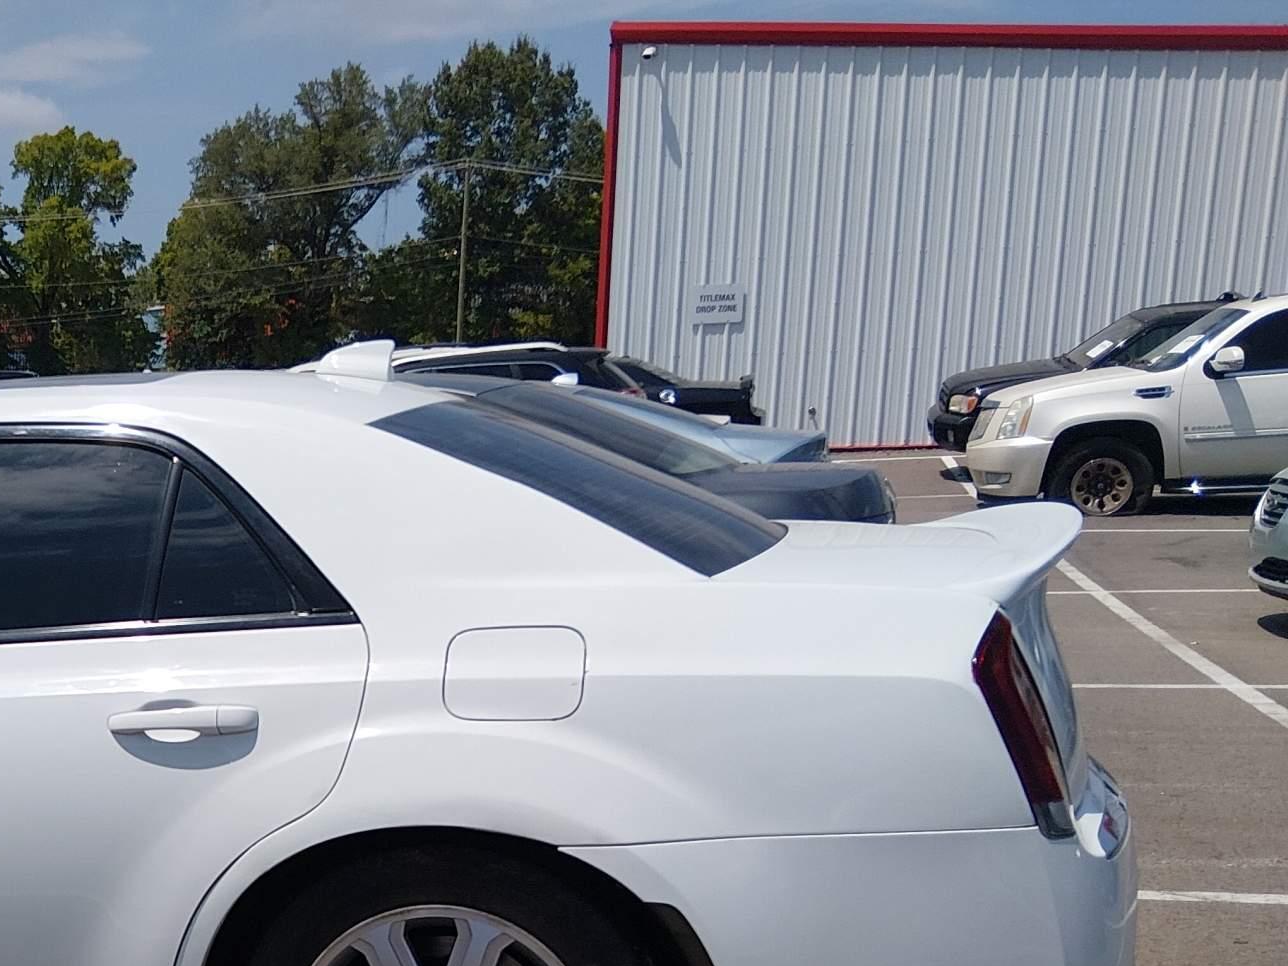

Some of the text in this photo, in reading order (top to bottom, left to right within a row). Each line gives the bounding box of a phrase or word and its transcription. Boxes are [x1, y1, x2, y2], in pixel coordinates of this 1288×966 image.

[699, 293, 736, 302] TITLEMAX
[695, 304, 738, 314] DROP ZONE
